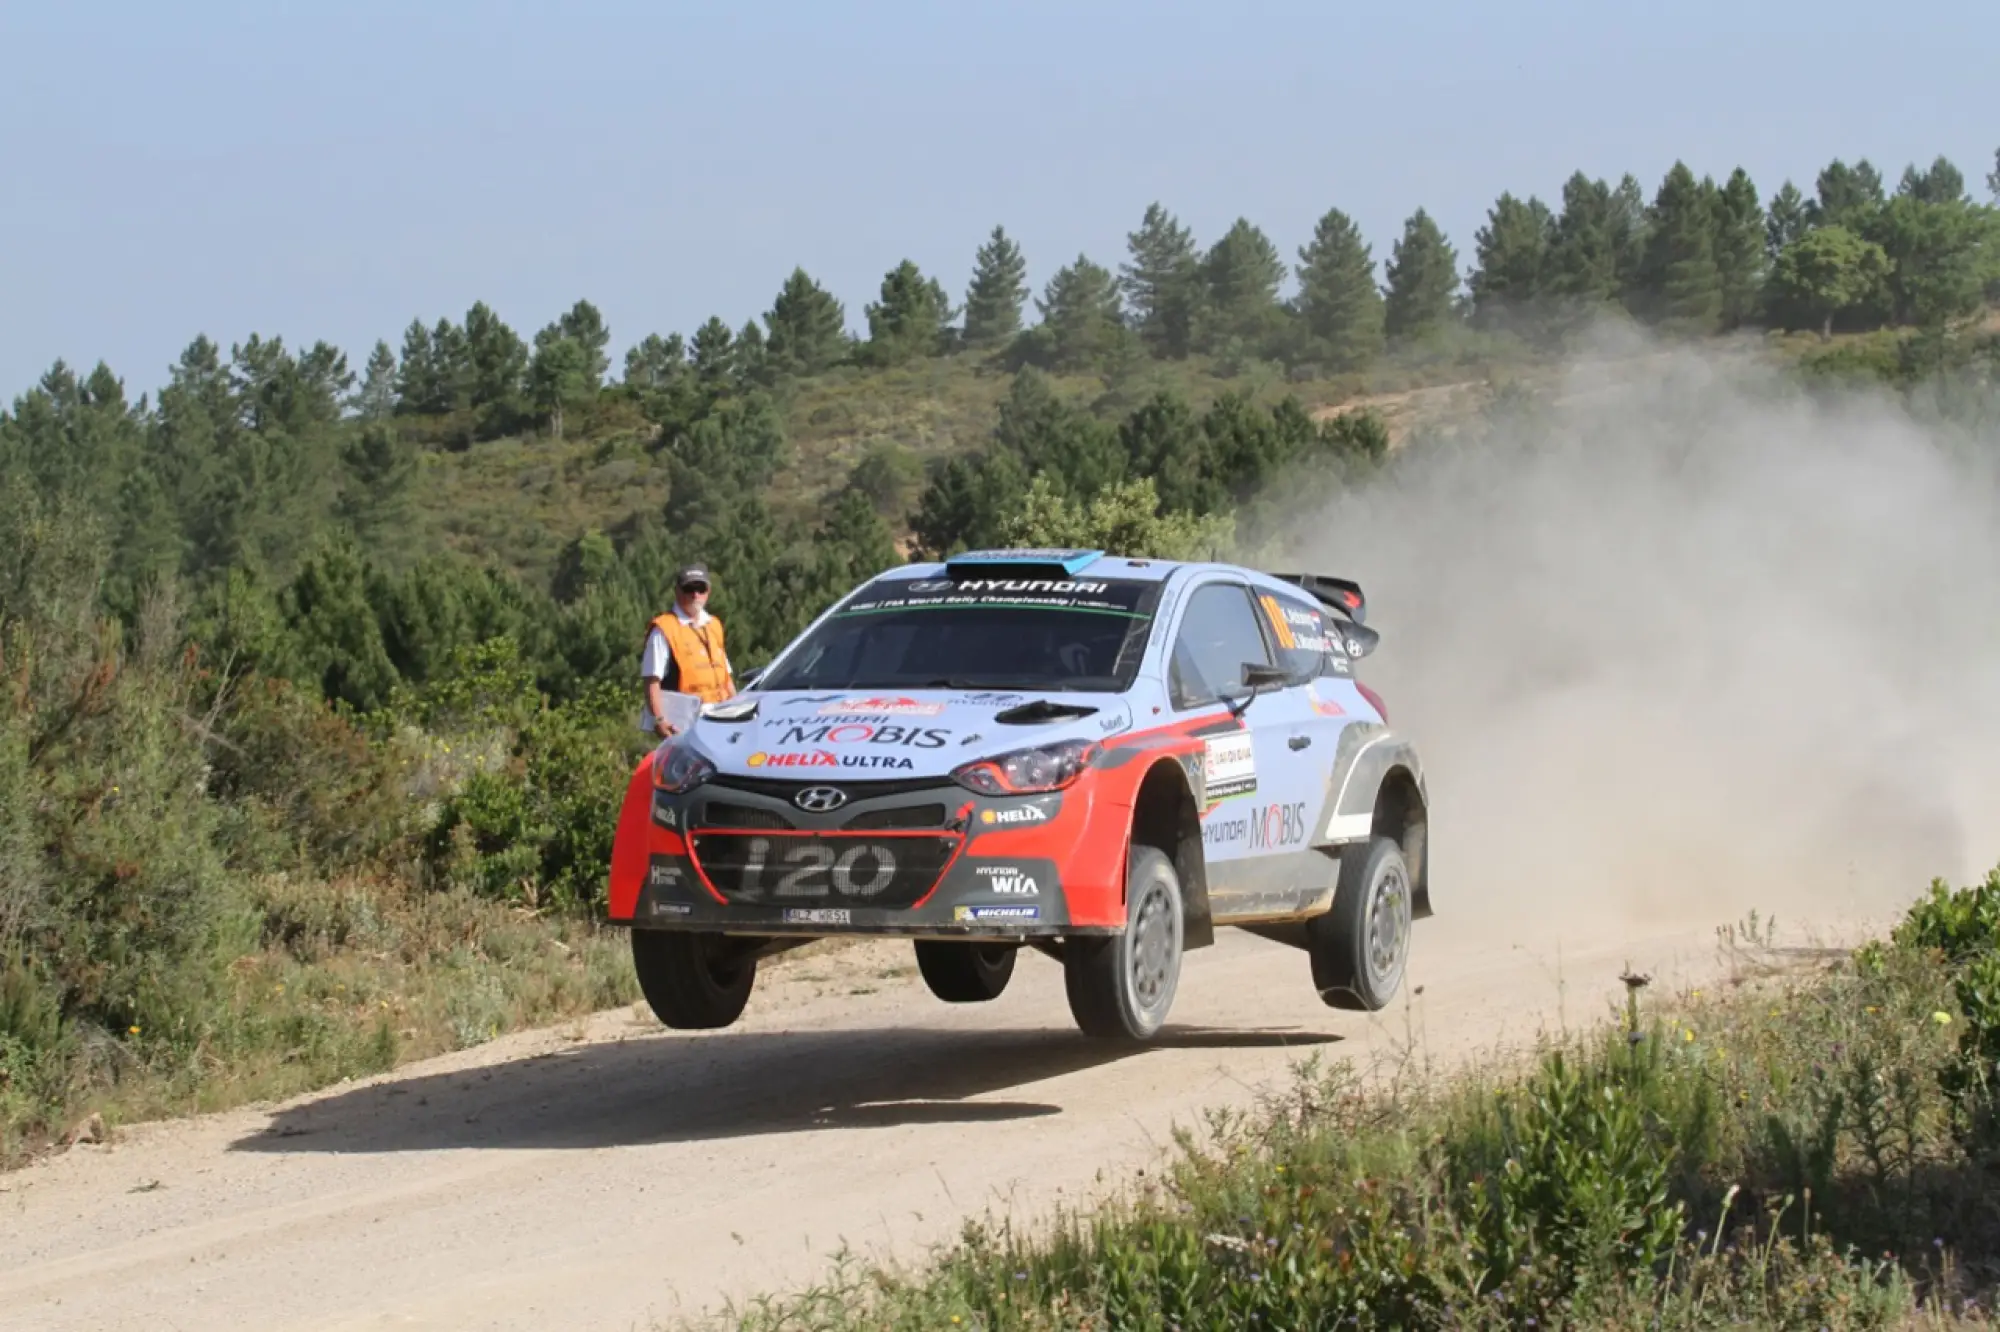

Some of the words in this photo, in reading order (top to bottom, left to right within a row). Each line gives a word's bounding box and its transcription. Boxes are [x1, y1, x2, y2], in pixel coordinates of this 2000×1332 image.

[958, 580, 1109, 594] HYUNDAI
[908, 597, 944, 606] World
[946, 596, 977, 605] Rally
[980, 595, 1070, 606] Championship
[763, 715, 890, 727] HYUNDAI
[777, 724, 953, 749] MOBIS
[767, 750, 839, 768] HELIX
[842, 755, 914, 770] ULTRA
[996, 804, 1047, 823] HELIX
[1201, 819, 1247, 845] HYUNDAI
[1249, 802, 1306, 850] MOBIS
[976, 866, 1018, 875] HYUNDAI
[977, 908, 1036, 917] MICHELIN
